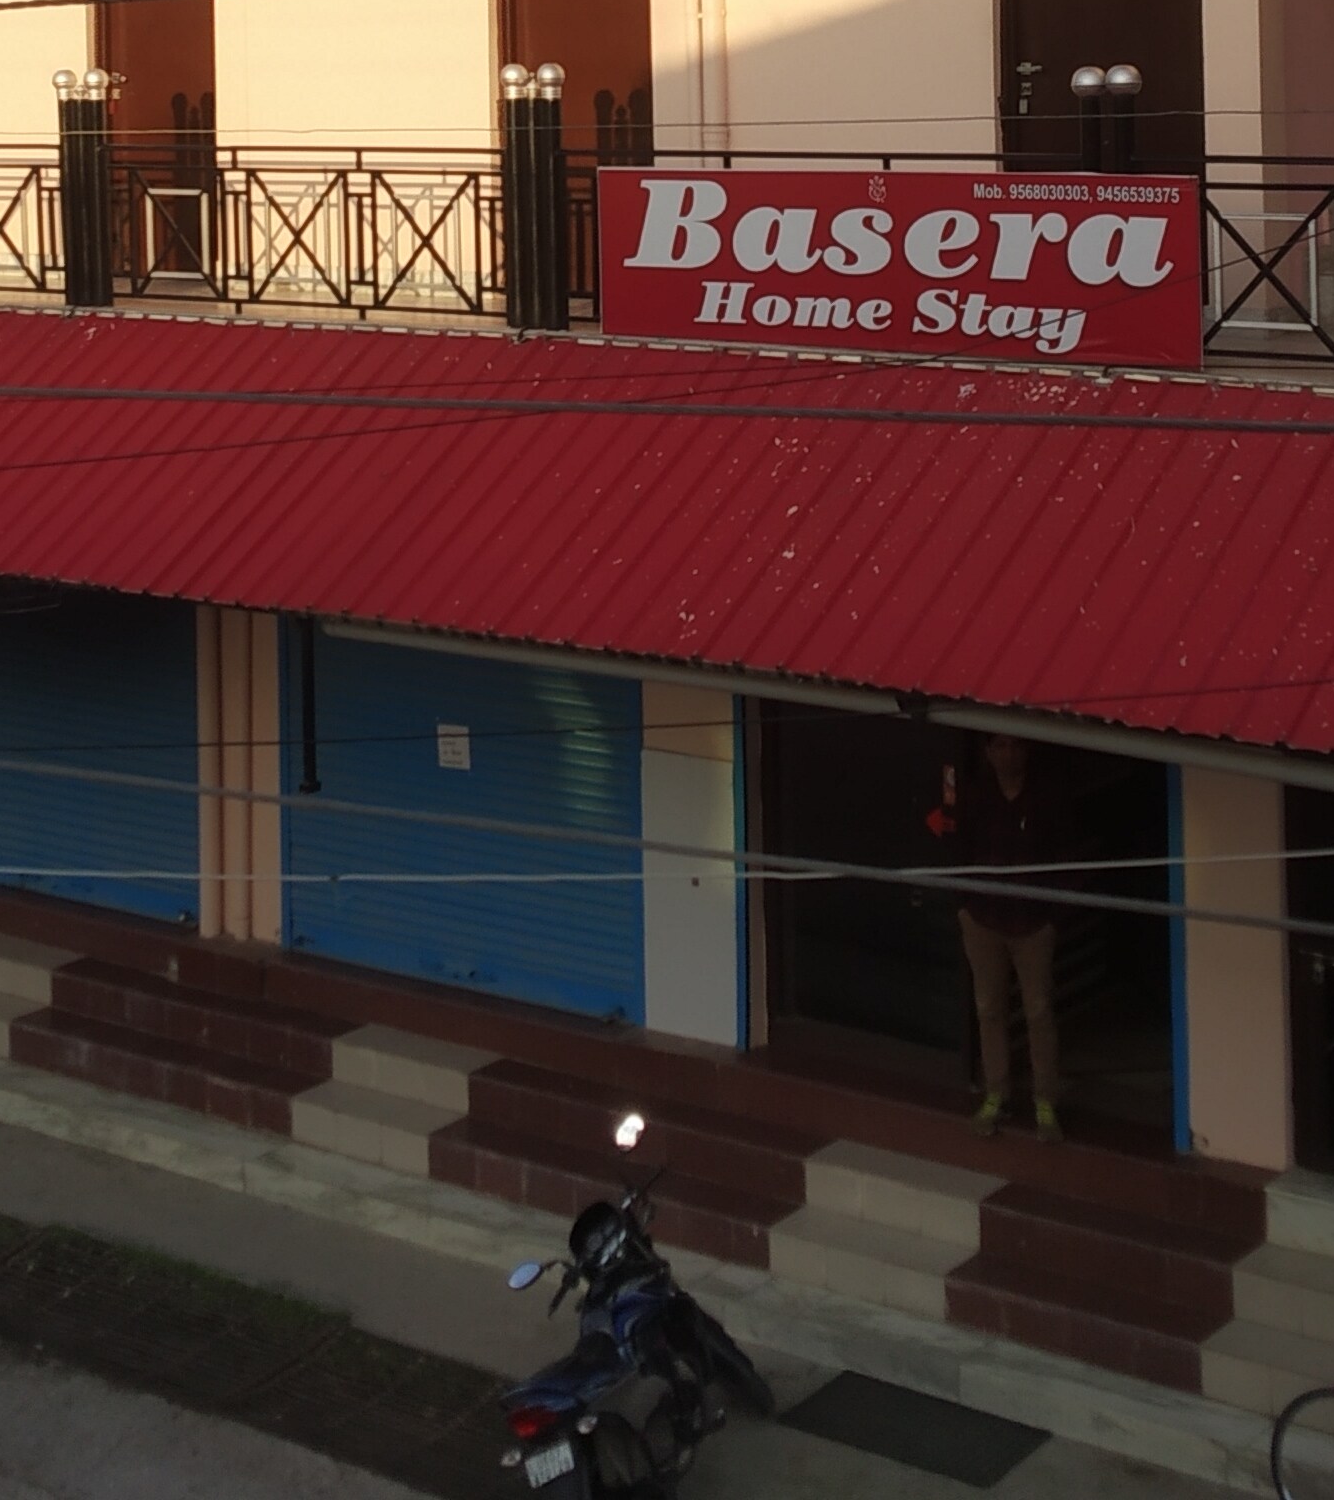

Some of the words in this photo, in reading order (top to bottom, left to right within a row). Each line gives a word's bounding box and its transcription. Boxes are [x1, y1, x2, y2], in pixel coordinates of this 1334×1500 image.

[973, 183, 1006, 199] Mob.
[1009, 184, 1093, 204] 9568030303,
[1096, 186, 1180, 204] 9456539375
[623, 179, 1174, 288] Basera
[693, 281, 893, 330] Home
[912, 288, 1087, 354] Stay
